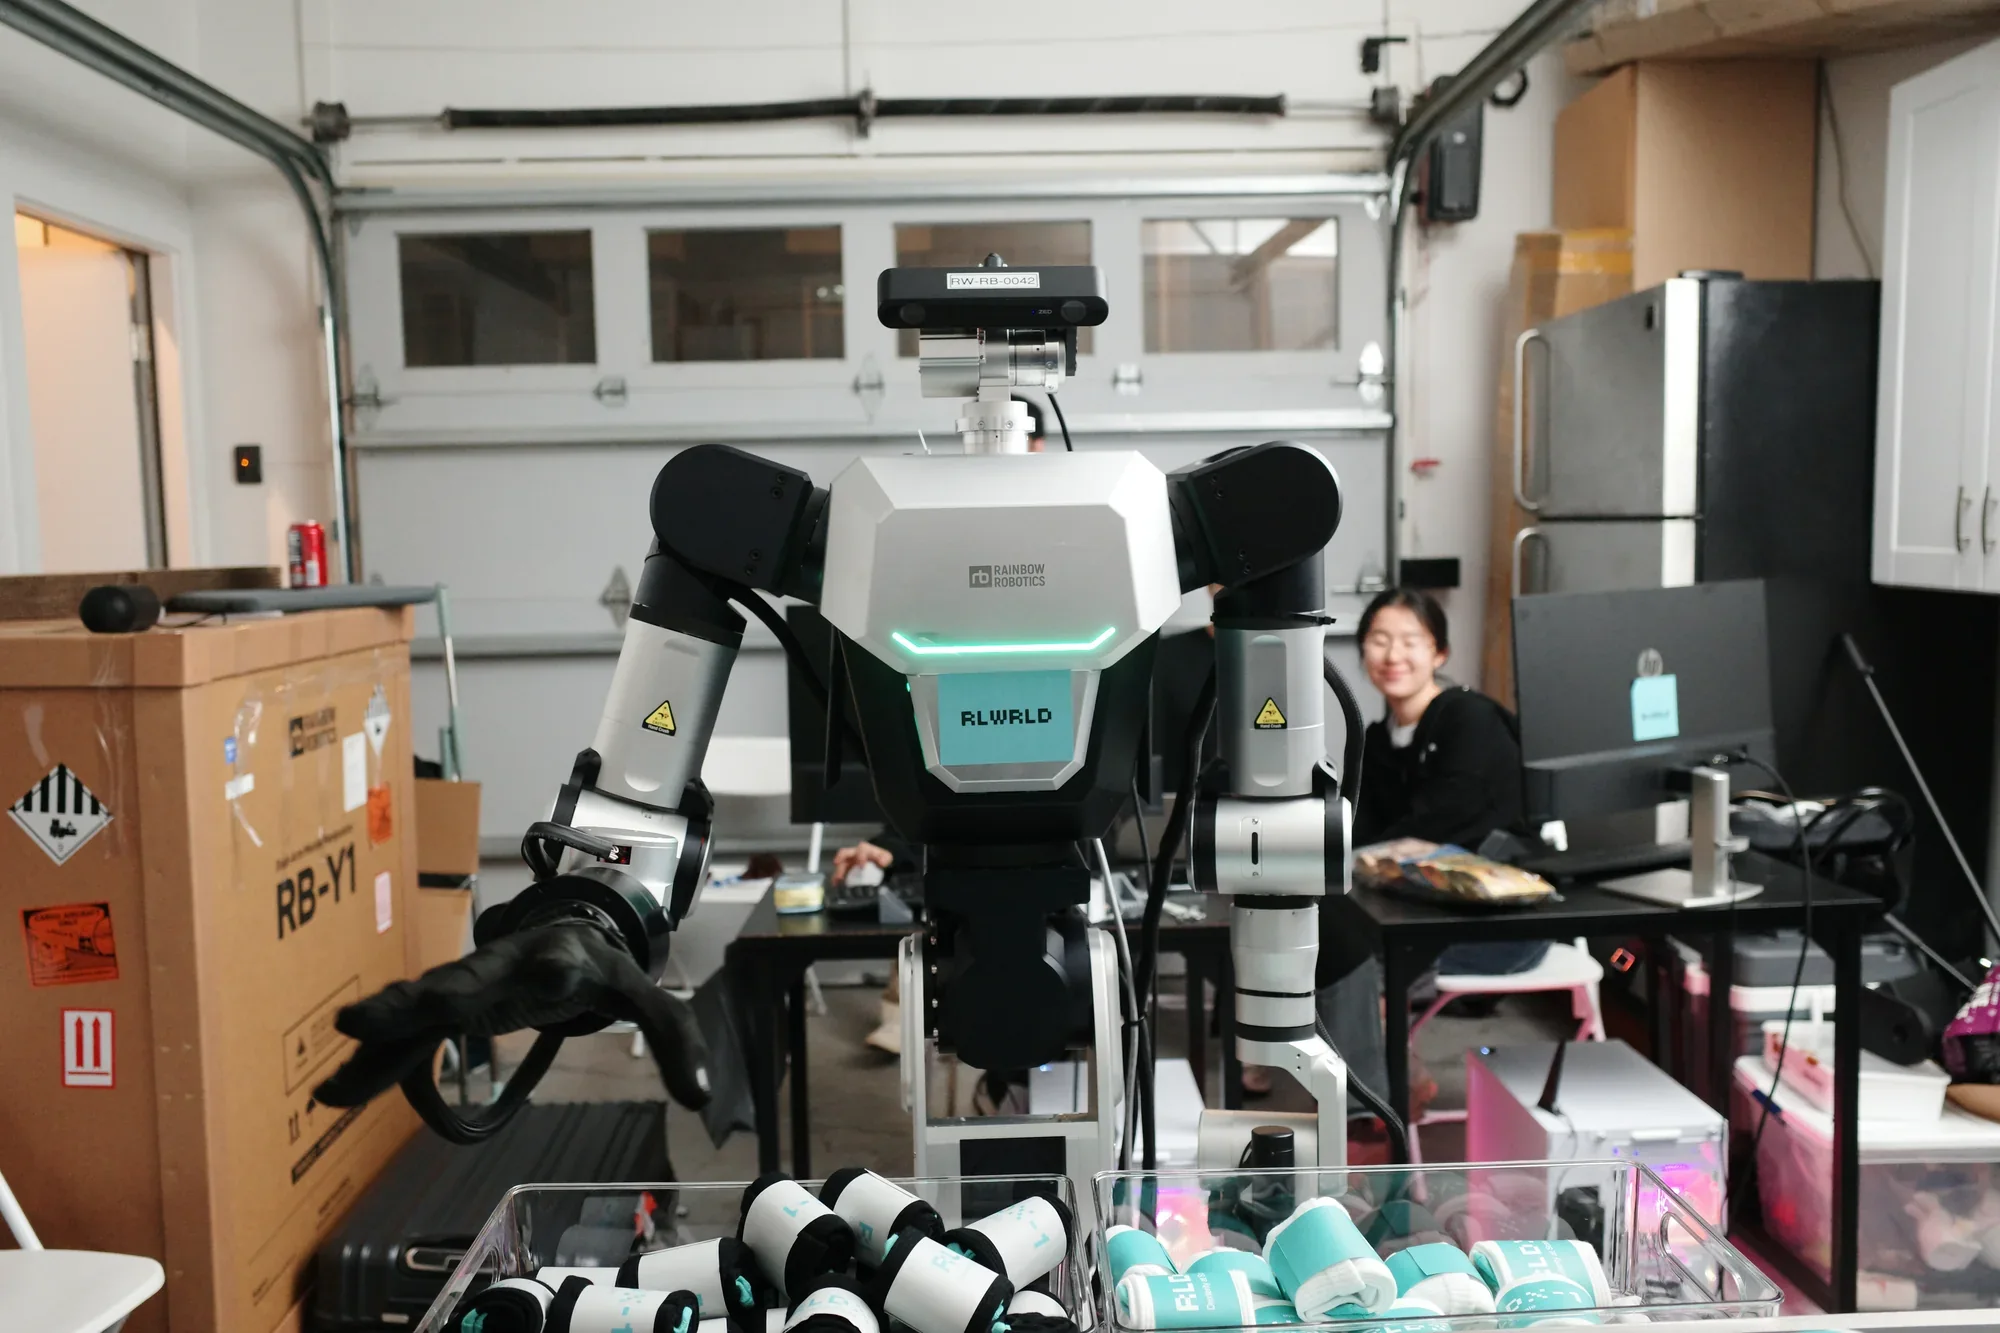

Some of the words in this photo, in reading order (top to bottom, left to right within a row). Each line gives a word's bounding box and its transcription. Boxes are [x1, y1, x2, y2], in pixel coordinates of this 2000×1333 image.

[951, 276, 1036, 286] RW-RB-0042
[994, 563, 1045, 576] RAINBOW
[994, 576, 1046, 588] ROBOTICS
[961, 708, 1052, 726] RLWRLD
[277, 841, 356, 940] RB-Y1
